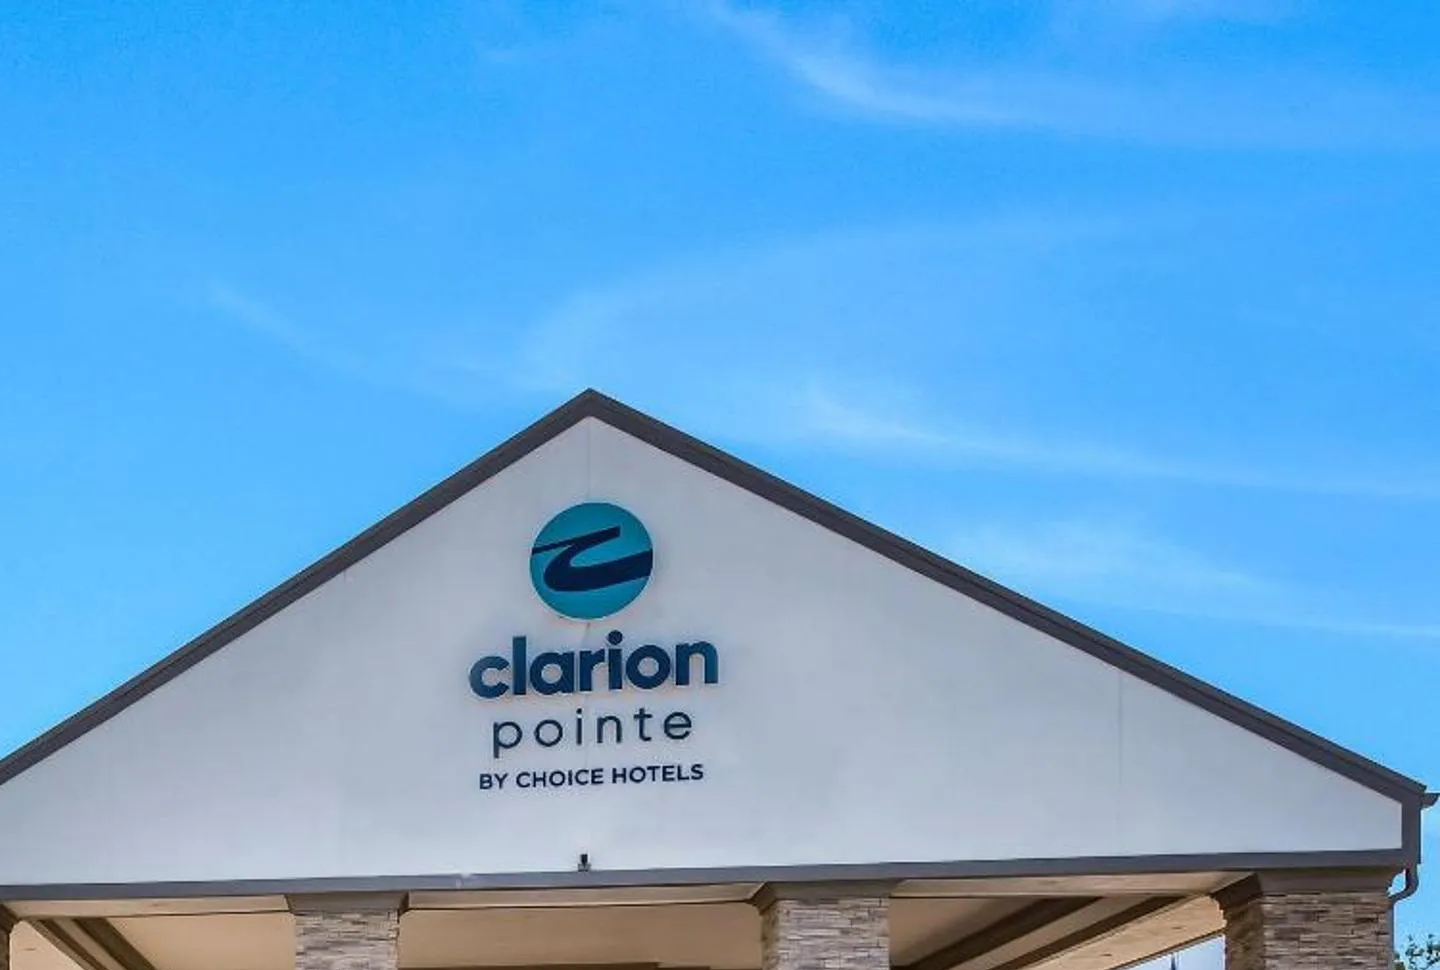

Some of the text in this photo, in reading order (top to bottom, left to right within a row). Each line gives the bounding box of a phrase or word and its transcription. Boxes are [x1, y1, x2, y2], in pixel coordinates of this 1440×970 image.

[468, 630, 719, 699] clarion
[492, 707, 693, 759] pointe
[479, 763, 704, 790] BY CHOICE HOTELS
